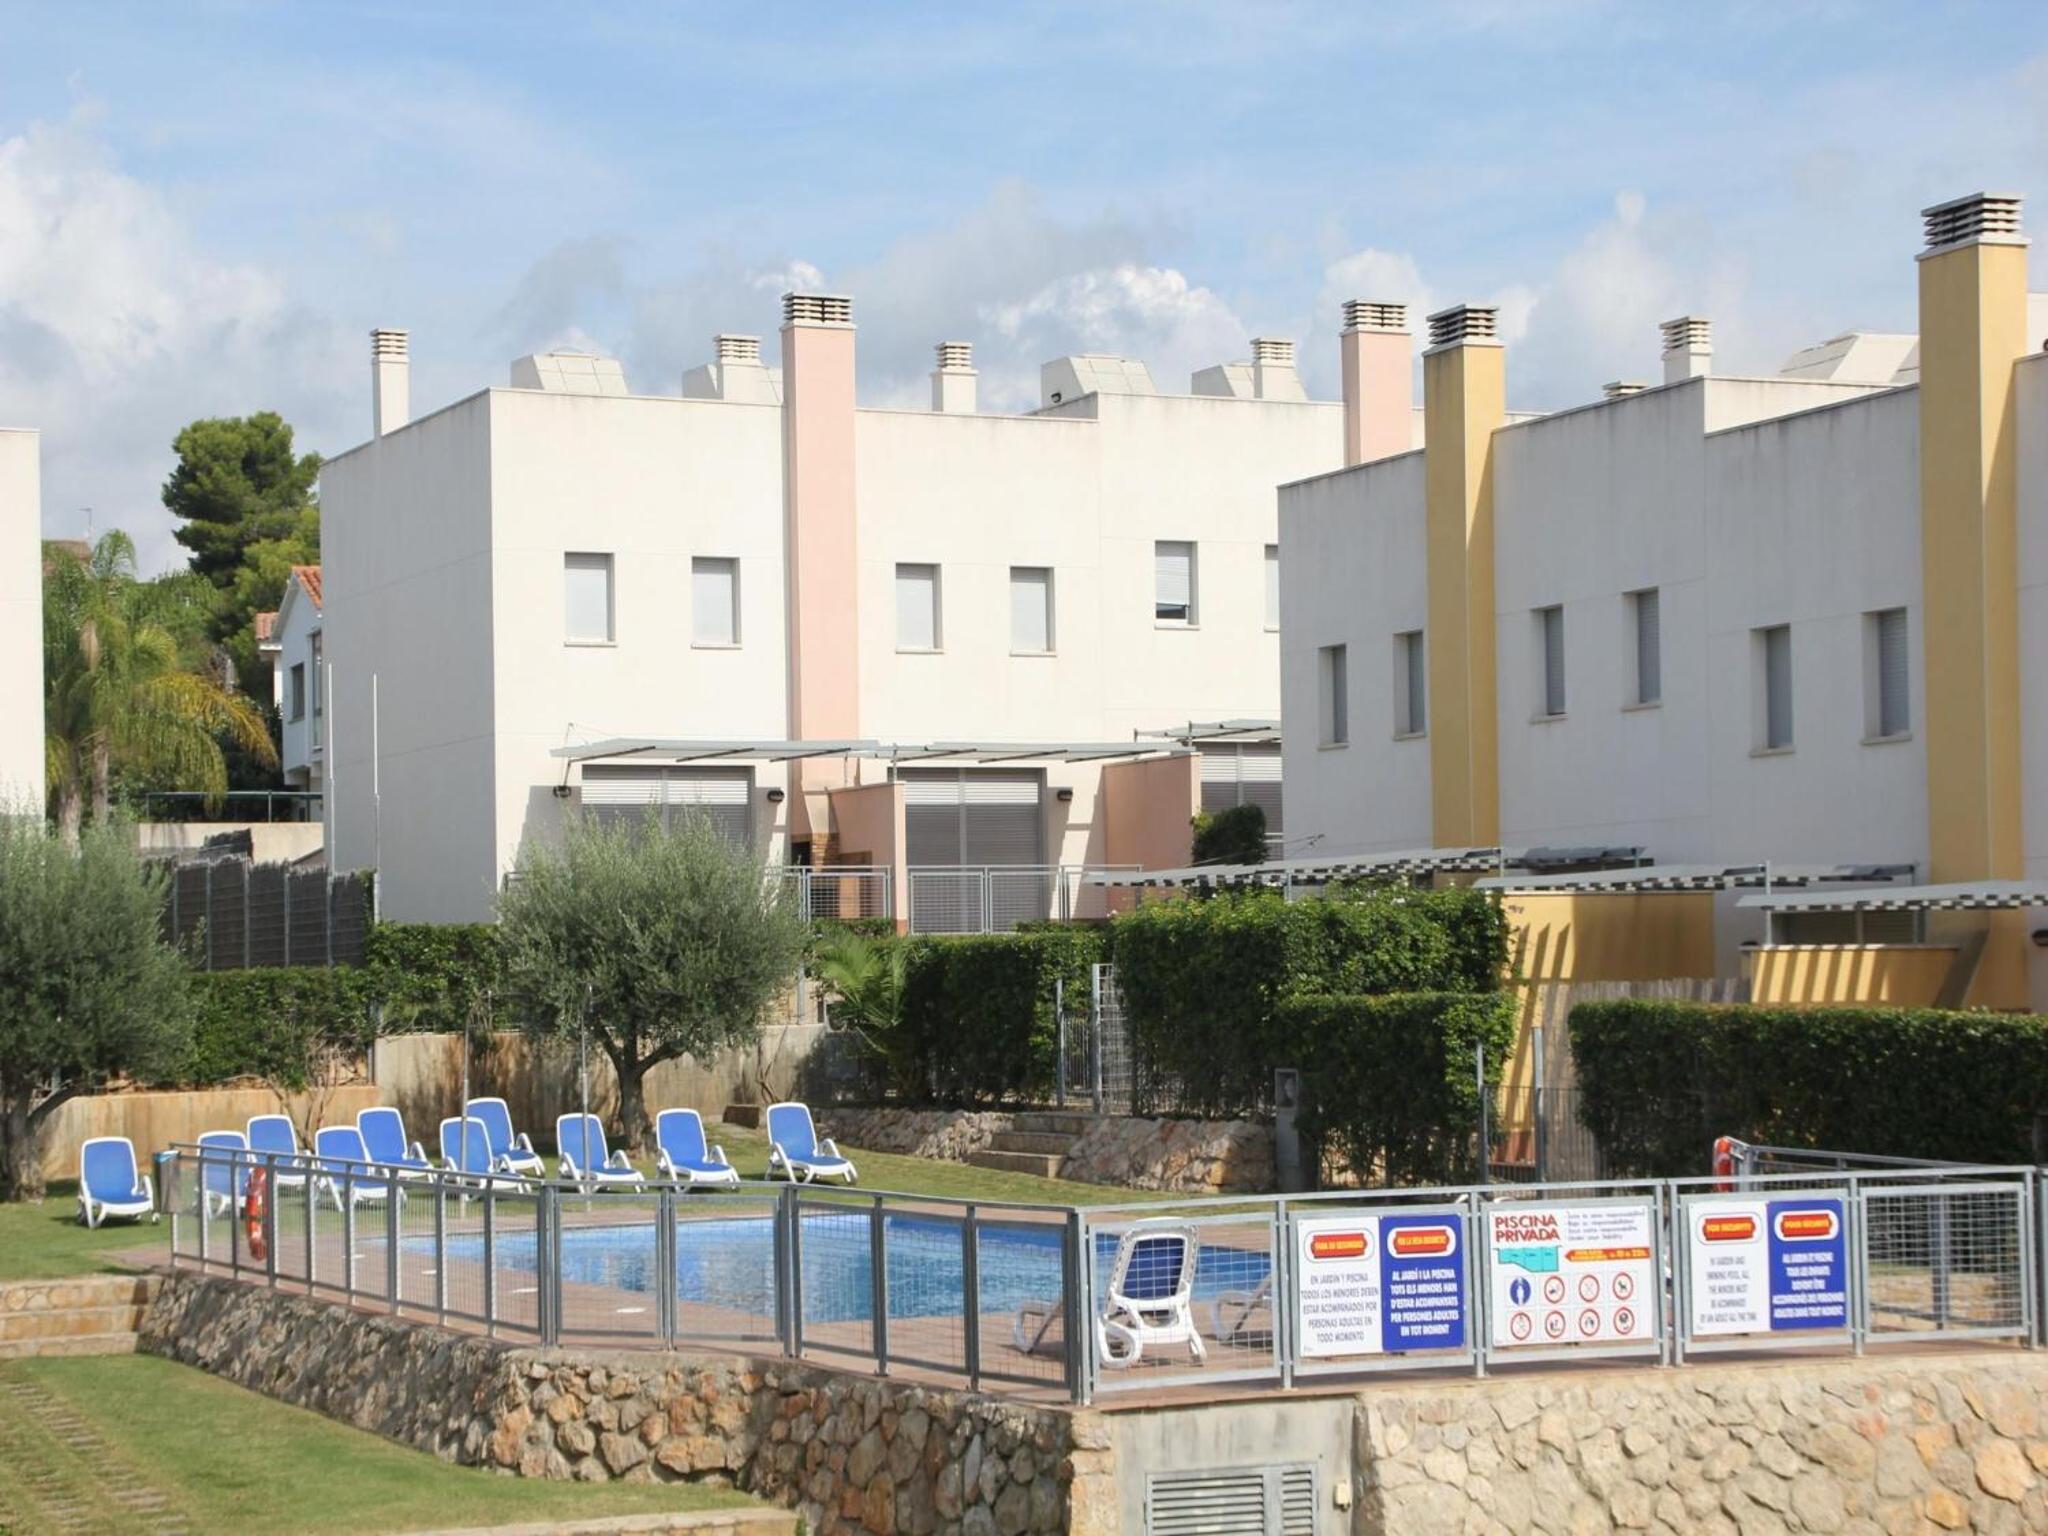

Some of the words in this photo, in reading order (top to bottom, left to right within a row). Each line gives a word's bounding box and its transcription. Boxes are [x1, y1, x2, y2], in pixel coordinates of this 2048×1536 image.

[1495, 1214, 1558, 1230] PISCINA
[1496, 1228, 1561, 1243] PRIVADA
[1392, 1271, 1401, 1281] AL
[1432, 1269, 1456, 1279] PISCINA
[1301, 1290, 1320, 1300] TODOS
[1321, 1289, 1332, 1299] LOS
[1333, 1288, 1360, 1299] MENORES
[1303, 1305, 1320, 1315] ESTAR
[1366, 1302, 1377, 1312] POR
[1308, 1318, 1338, 1329] PERSONAS
[1339, 1317, 1363, 1327] ADULTAS
[1317, 1333, 1334, 1344] TODO
[1335, 1332, 1365, 1342] MOMENTO
